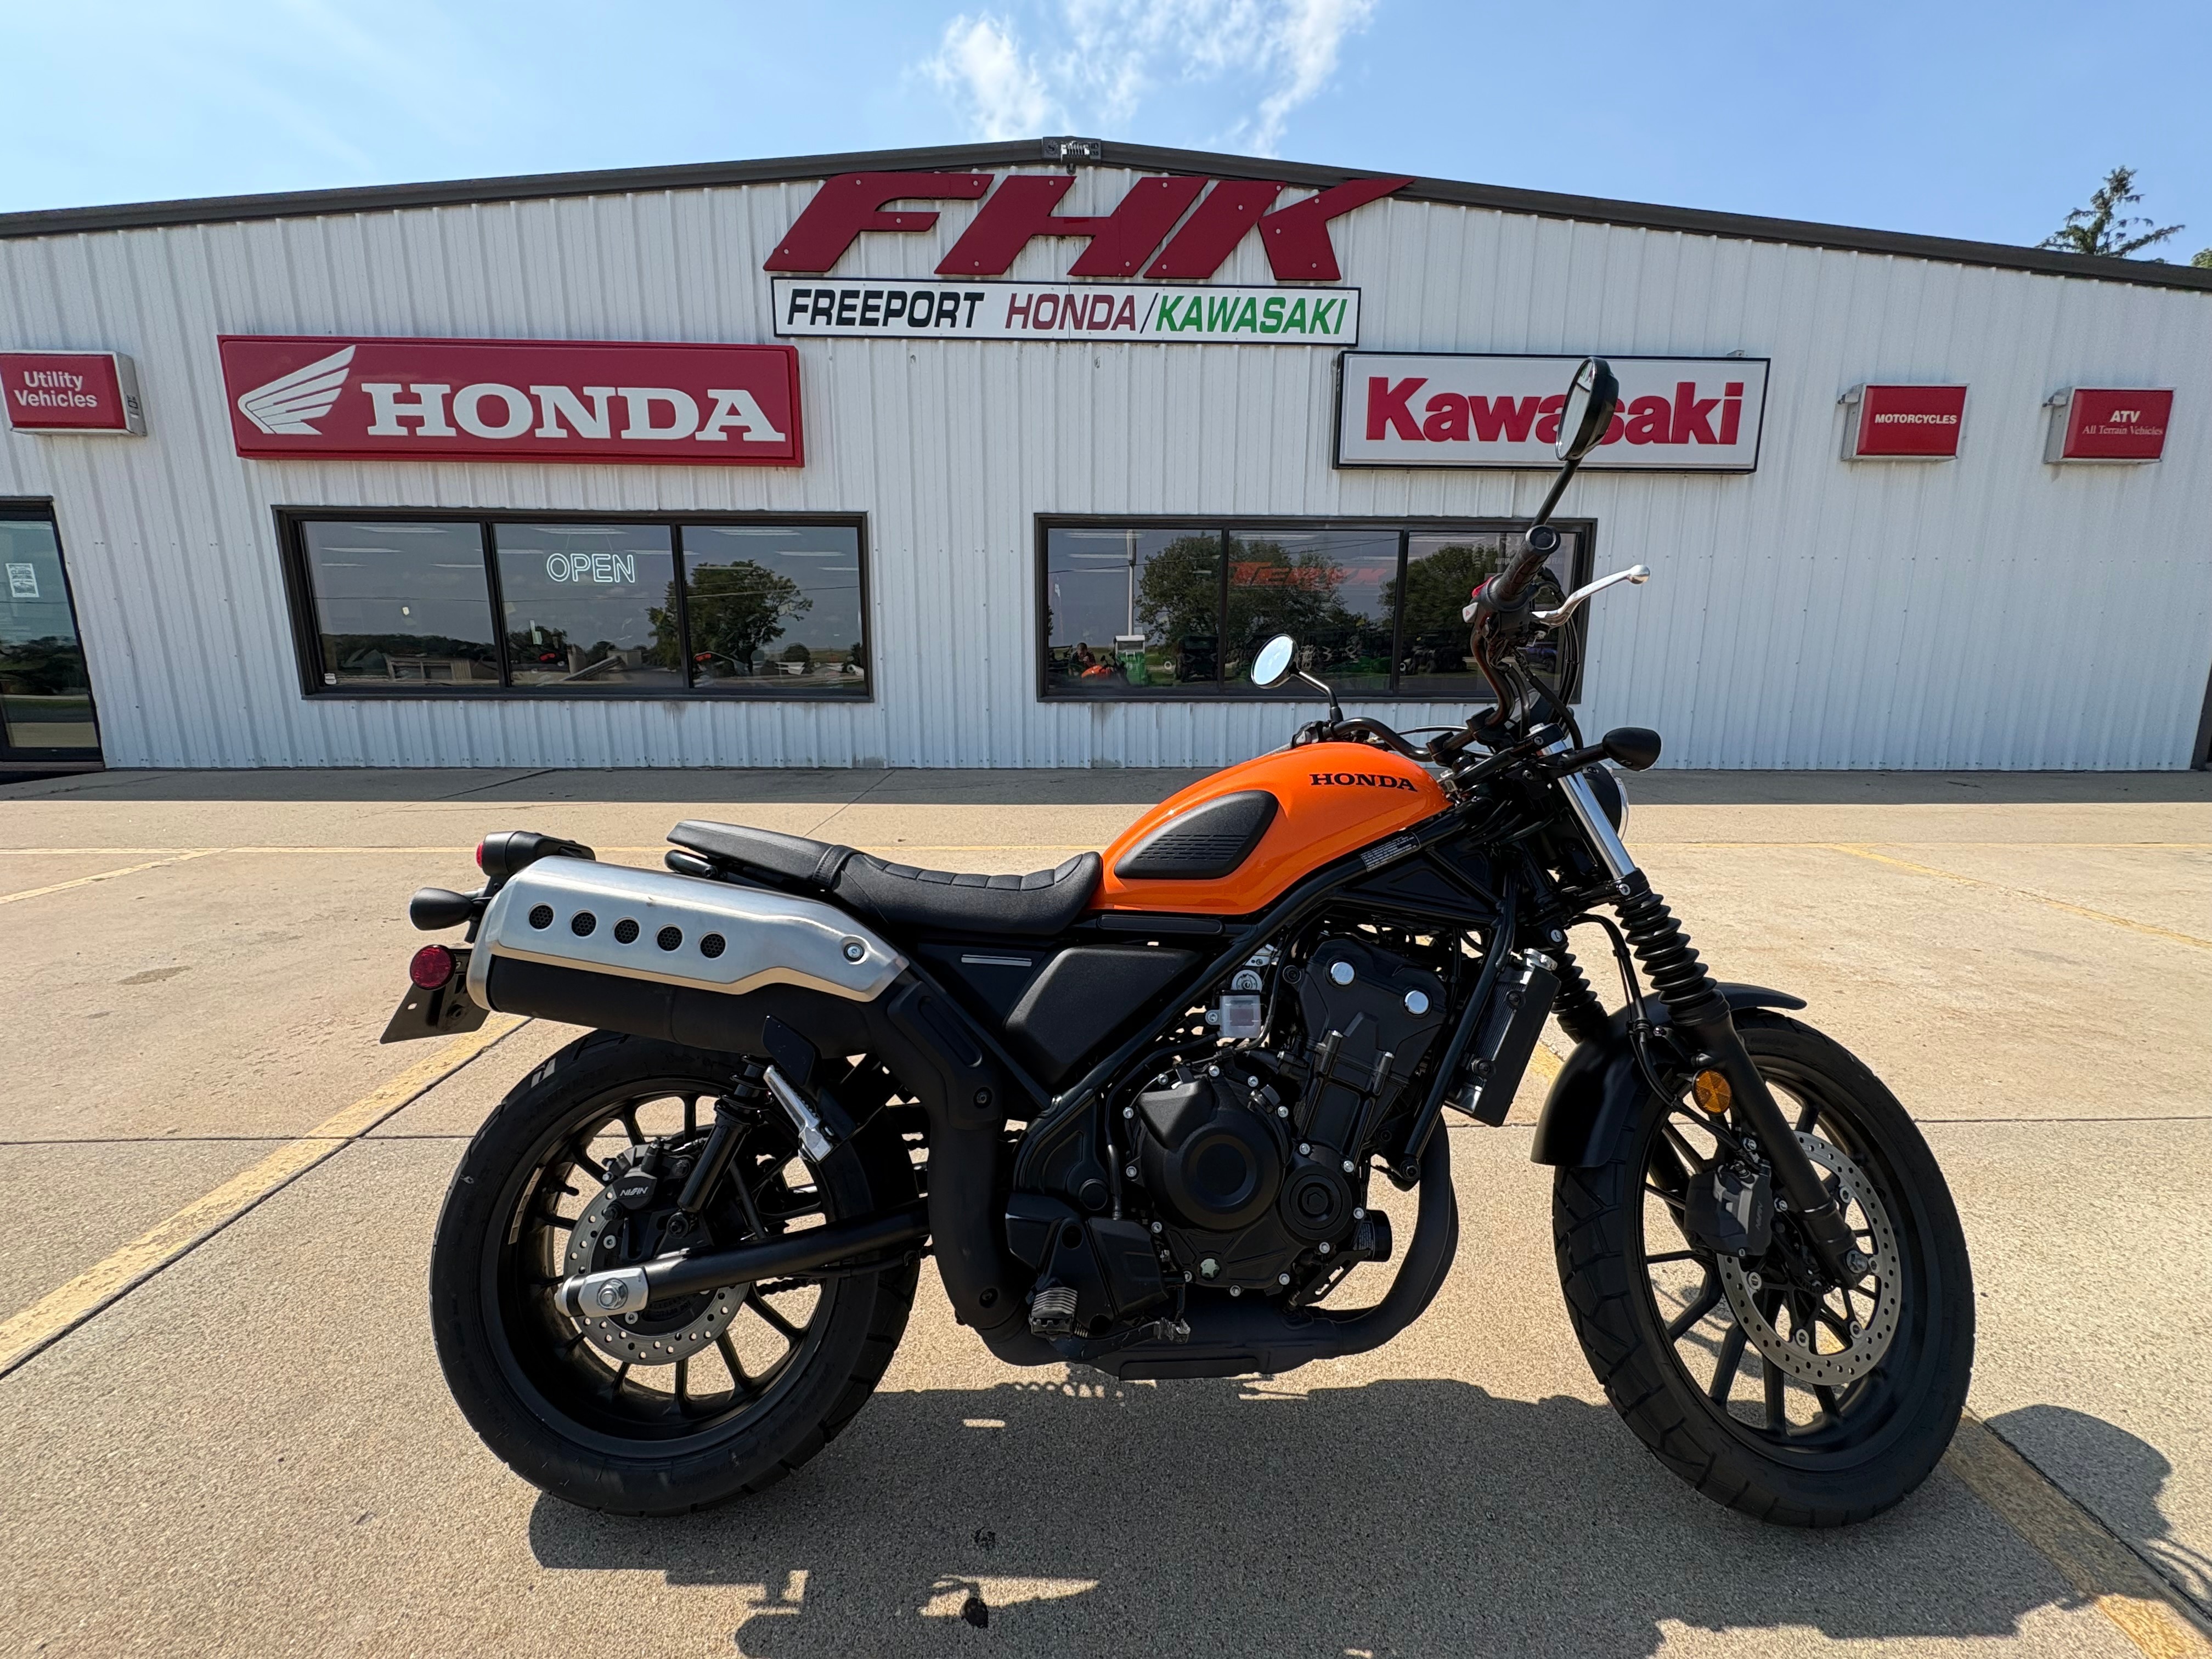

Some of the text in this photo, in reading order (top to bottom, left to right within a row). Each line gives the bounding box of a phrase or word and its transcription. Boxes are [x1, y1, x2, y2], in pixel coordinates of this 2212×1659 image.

[763, 172, 1412, 280] FHK
[787, 289, 1347, 334] FREEPORT HONDA/KAWASAKI
[24, 371, 83, 392] Utility
[14, 389, 98, 408] Vehicles
[361, 383, 786, 442] HONDA
[1875, 414, 1957, 425] MOTORCYCLES
[2109, 410, 2141, 423] ATV
[2082, 425, 2164, 435] All Terrain Vehicles
[546, 553, 635, 583] OPEN
[1309, 772, 1419, 793] HONDA
